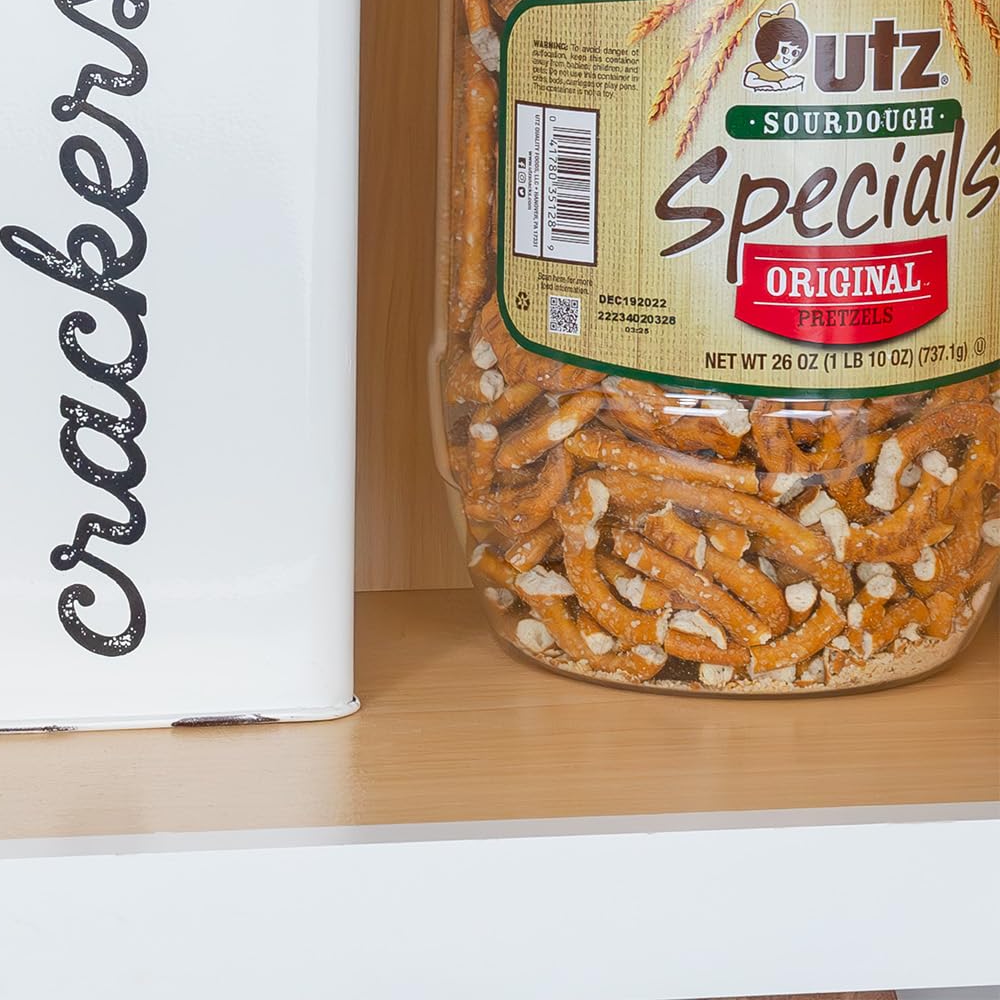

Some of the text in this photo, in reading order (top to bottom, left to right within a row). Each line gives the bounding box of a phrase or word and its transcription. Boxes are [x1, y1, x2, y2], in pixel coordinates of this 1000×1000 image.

[603, 47, 628, 56] danger
[549, 59, 565, 67] from
[570, 53, 587, 62] keep
[605, 56, 640, 65] container
[583, 71, 596, 79] this
[597, 73, 630, 81] container
[603, 82, 618, 91] play
[763, 106, 935, 135] SOURDOUGH
[548, 138, 558, 181] 41780
[547, 187, 557, 228] 35128
[655, 118, 1000, 284] Specials
[532, 221, 539, 230] PA
[766, 262, 920, 298] ORIGINAL
[599, 294, 667, 308] DEC192022
[598, 311, 677, 325] 22234020328
[798, 307, 893, 327] PRETZELS
[705, 344, 968, 373] NET WT 26 OZ (1 LB 10 OZ) (737.1g)
